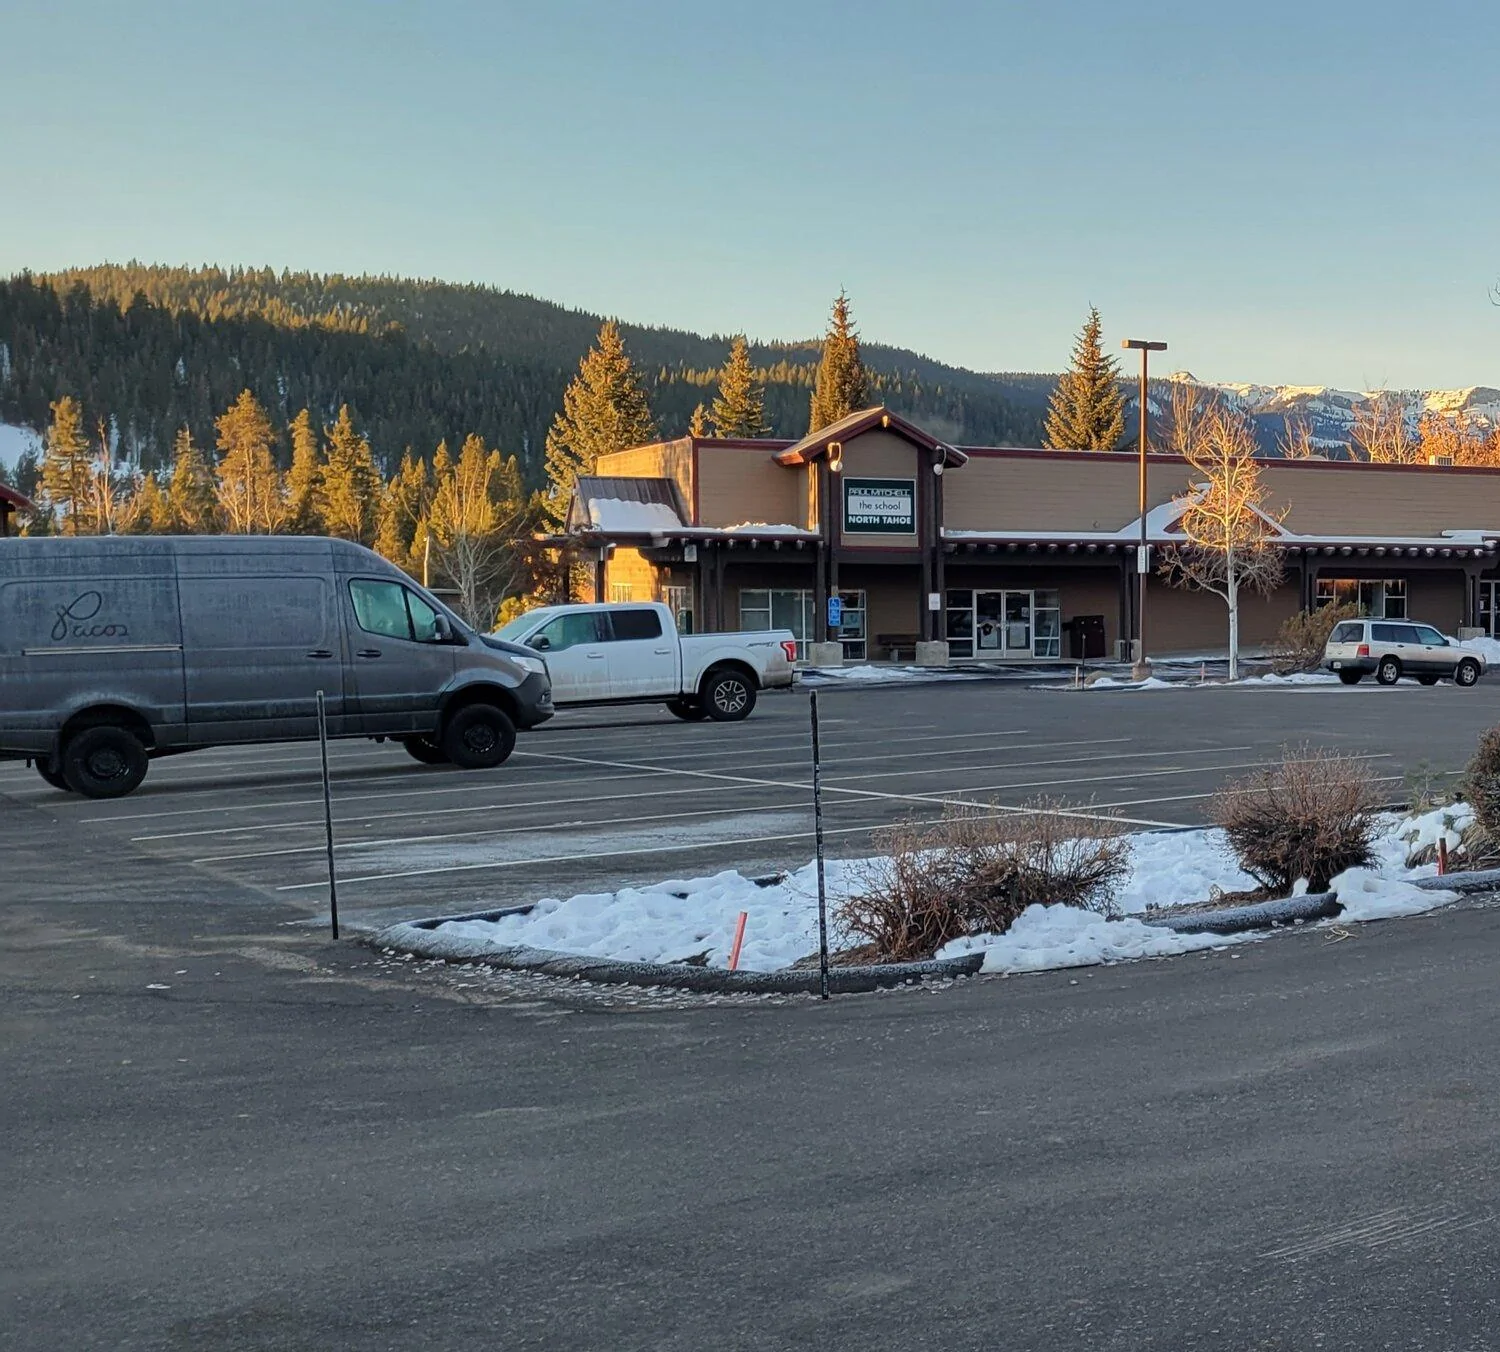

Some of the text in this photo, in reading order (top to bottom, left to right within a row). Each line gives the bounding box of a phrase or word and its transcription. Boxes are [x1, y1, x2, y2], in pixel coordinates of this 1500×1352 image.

[859, 500, 901, 510] the school
[848, 515, 911, 525] NORTH TAHOE
